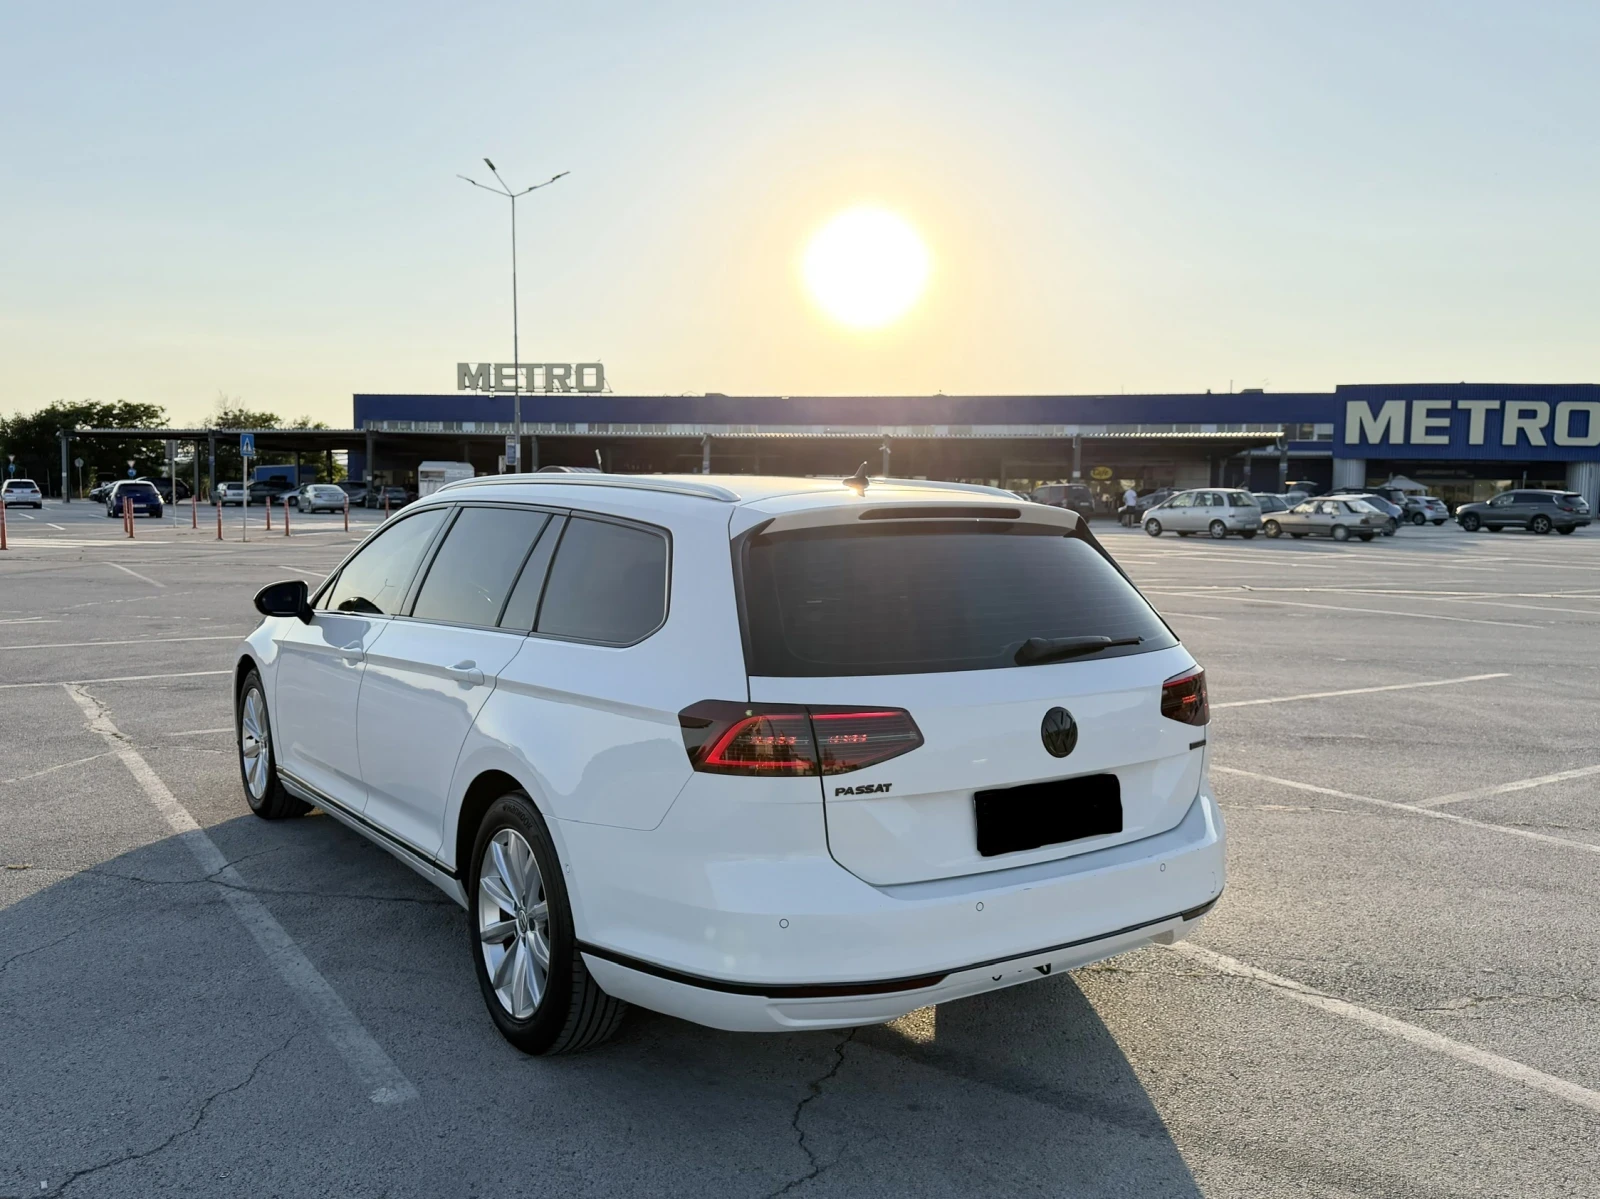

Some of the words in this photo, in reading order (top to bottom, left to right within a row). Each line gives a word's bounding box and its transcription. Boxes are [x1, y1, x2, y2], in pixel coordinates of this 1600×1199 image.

[457, 362, 604, 393] METRO
[1345, 400, 1600, 447] METRO
[835, 783, 892, 797] PASSAT
